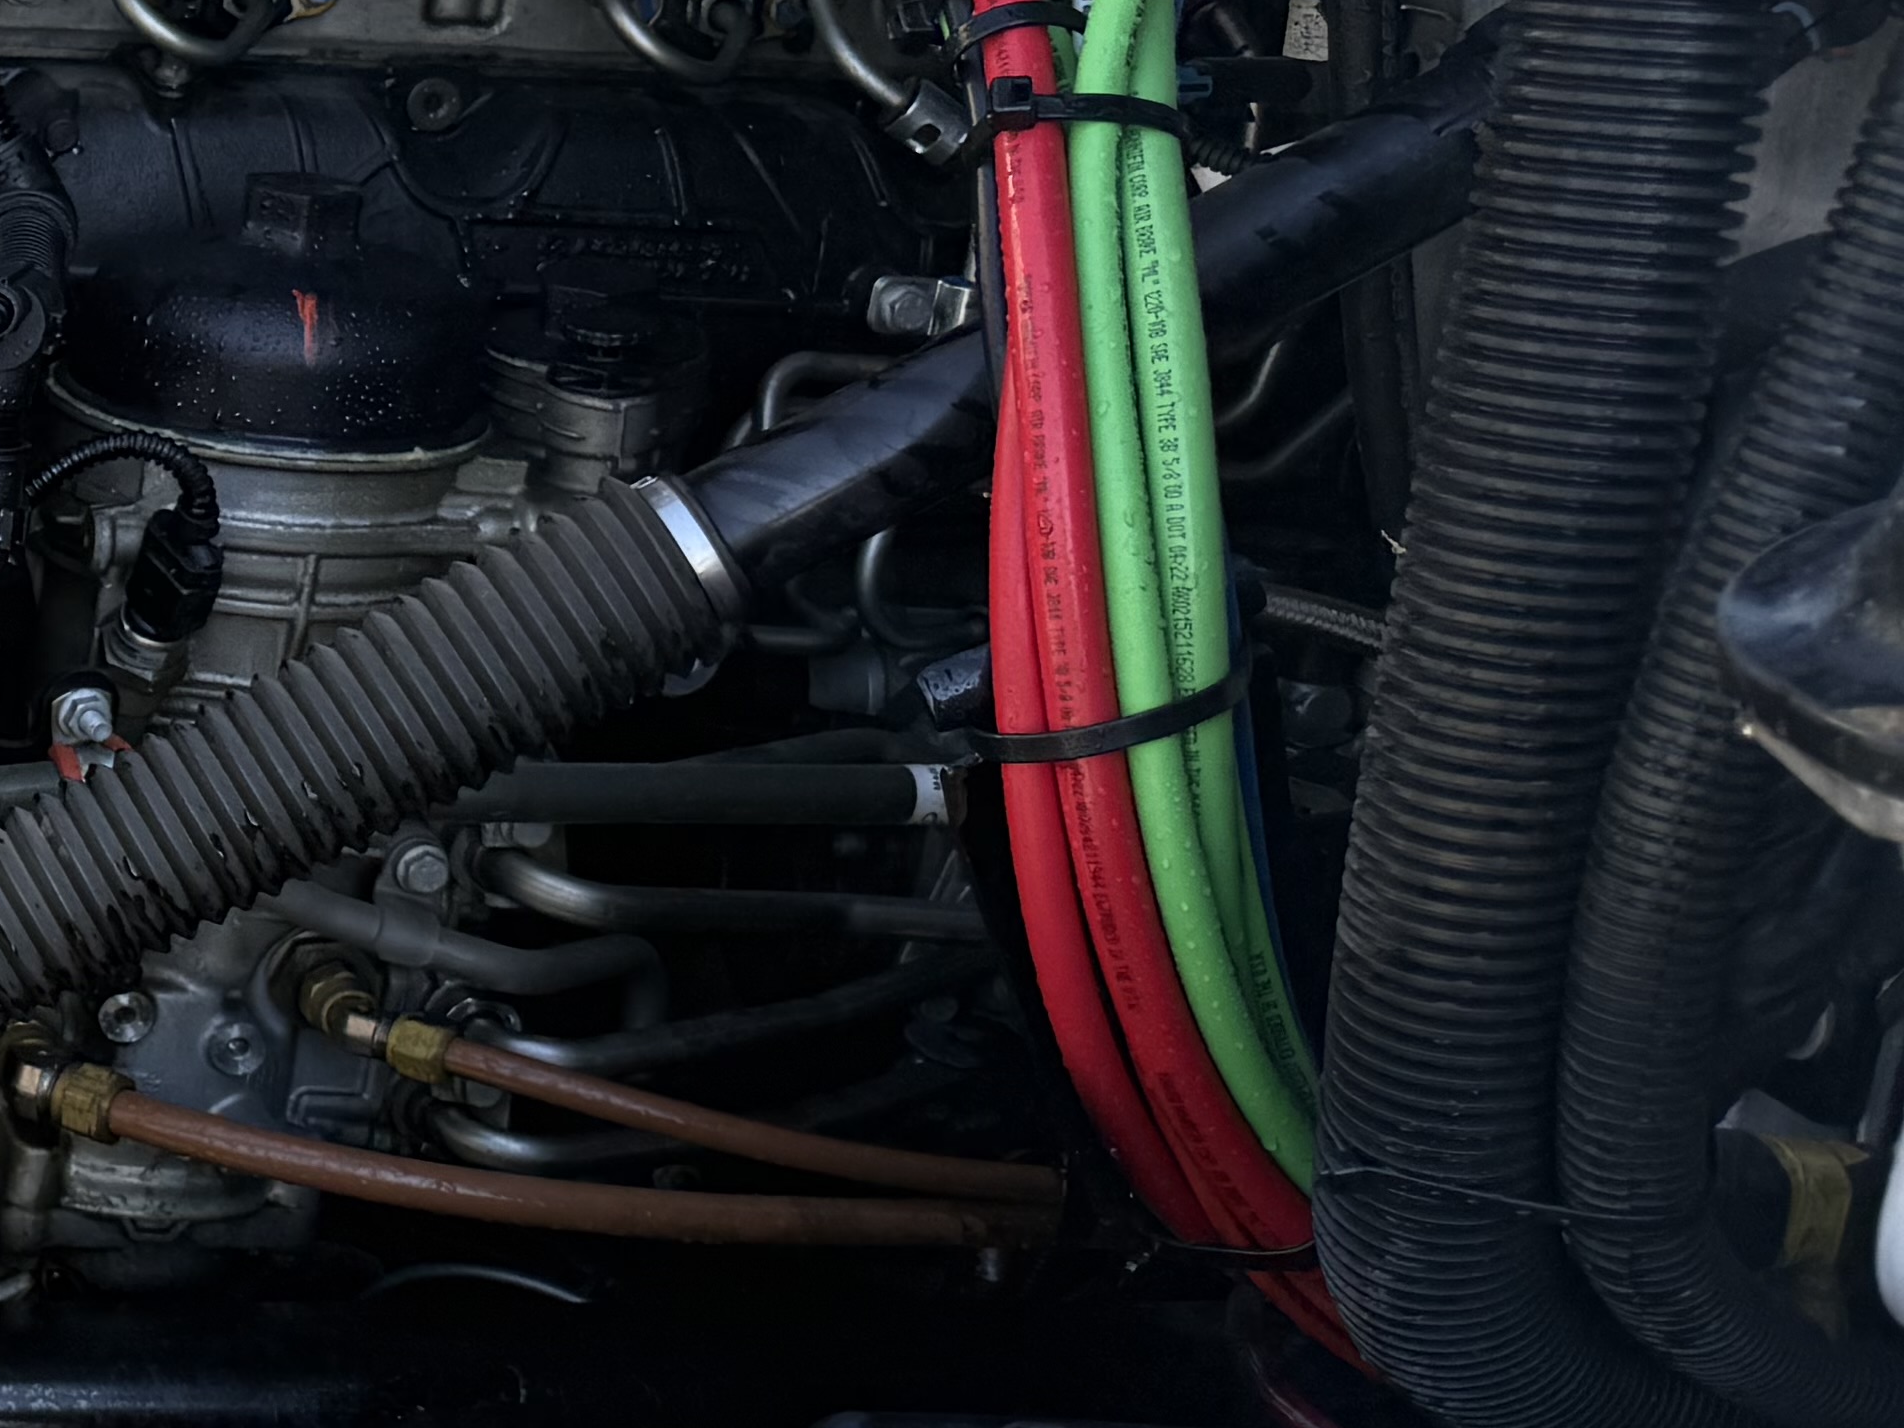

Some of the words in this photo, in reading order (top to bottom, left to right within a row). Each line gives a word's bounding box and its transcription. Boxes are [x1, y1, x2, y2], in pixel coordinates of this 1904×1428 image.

[1133, 203, 1153, 228] AIR
[1137, 226, 1158, 260] BRAKE
[1149, 338, 1170, 363] SAE
[1153, 366, 1171, 396] J844
[1156, 399, 1176, 433] TYPE
[1159, 434, 1176, 452] 3B
[1167, 501, 1184, 513] A
[1167, 515, 1187, 541] DOT
